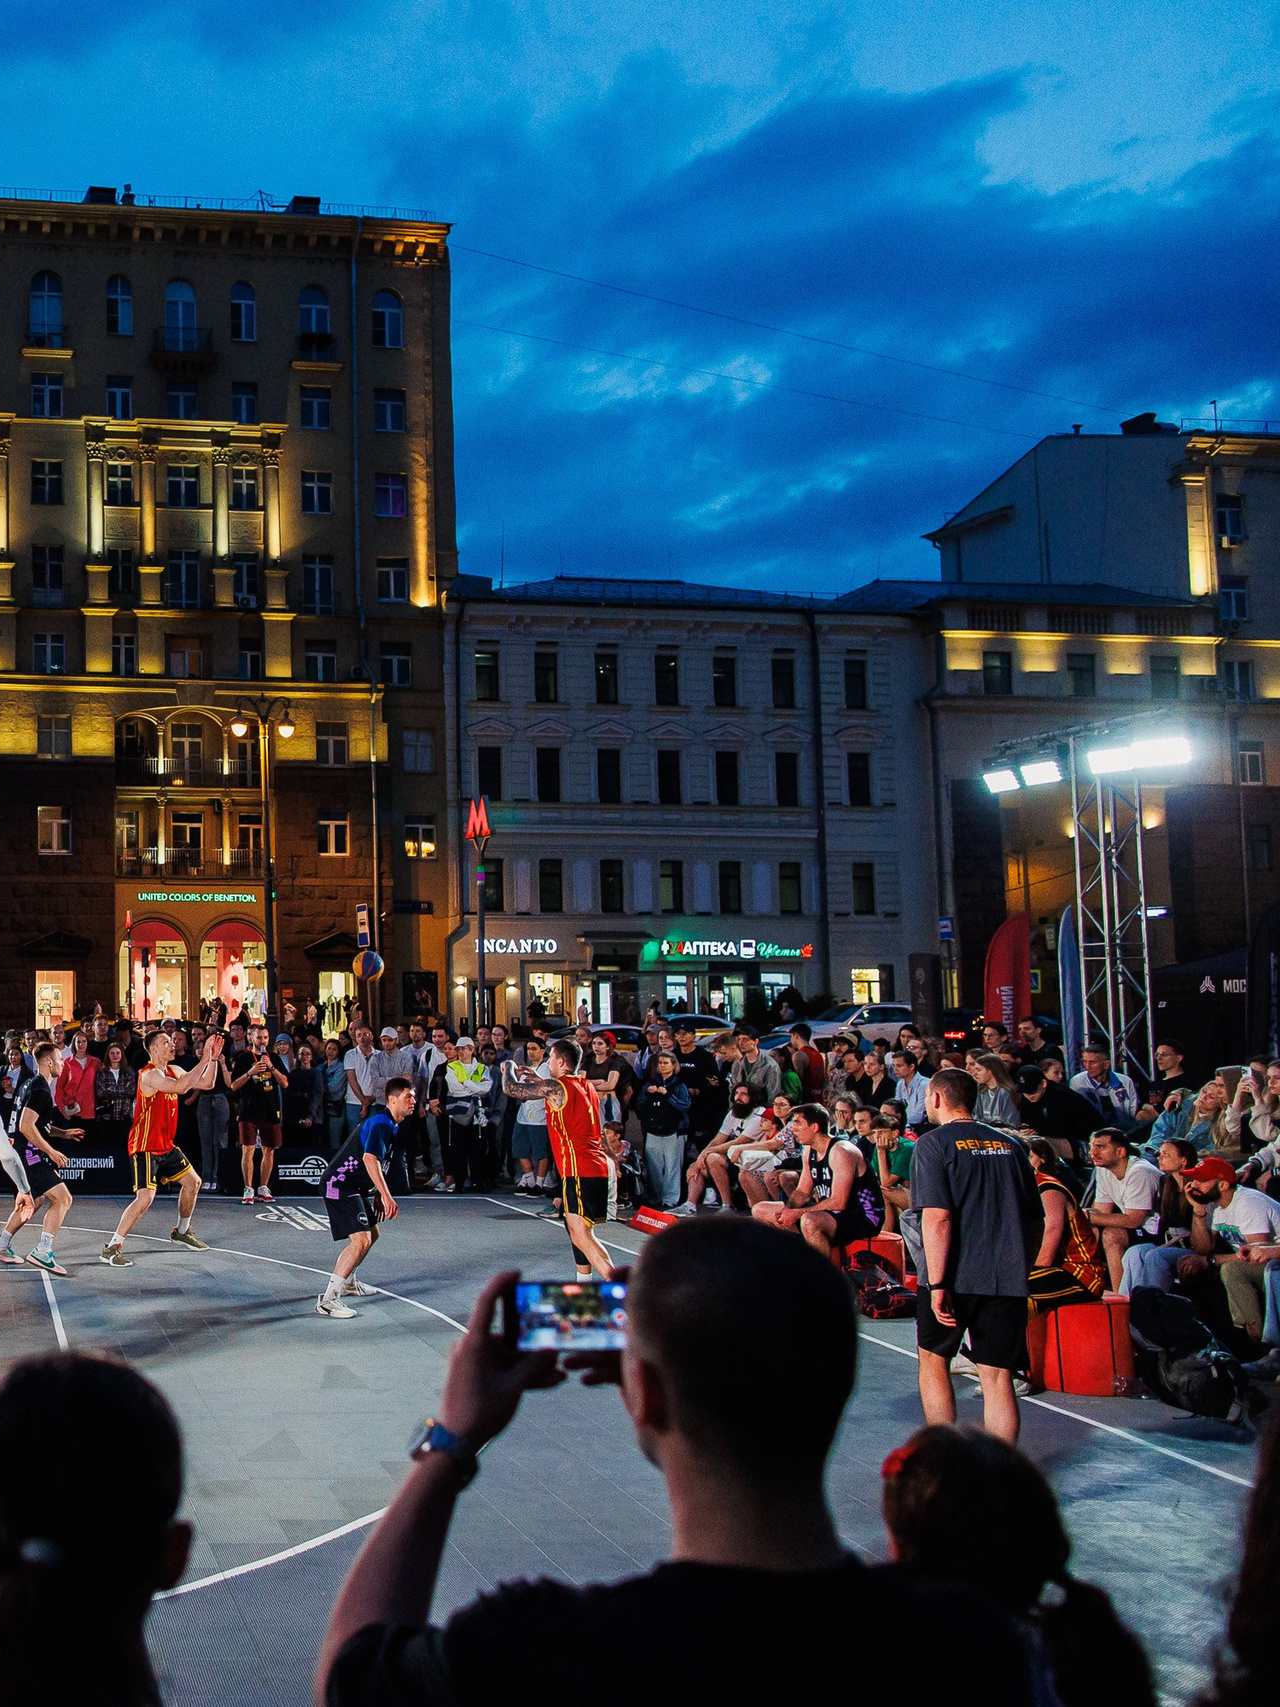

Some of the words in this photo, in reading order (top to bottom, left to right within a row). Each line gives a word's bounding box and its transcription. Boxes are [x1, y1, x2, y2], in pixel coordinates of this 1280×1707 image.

[137, 892, 168, 901] UNITED
[168, 893, 200, 902] COLORS
[201, 893, 214, 902] OF
[474, 938, 558, 954] INCANTO
[683, 941, 737, 955] АПТЕКА
[65, 1156, 114, 1168] ОСКОВСКИЙ
[59, 1169, 85, 1180] СПОРТ
